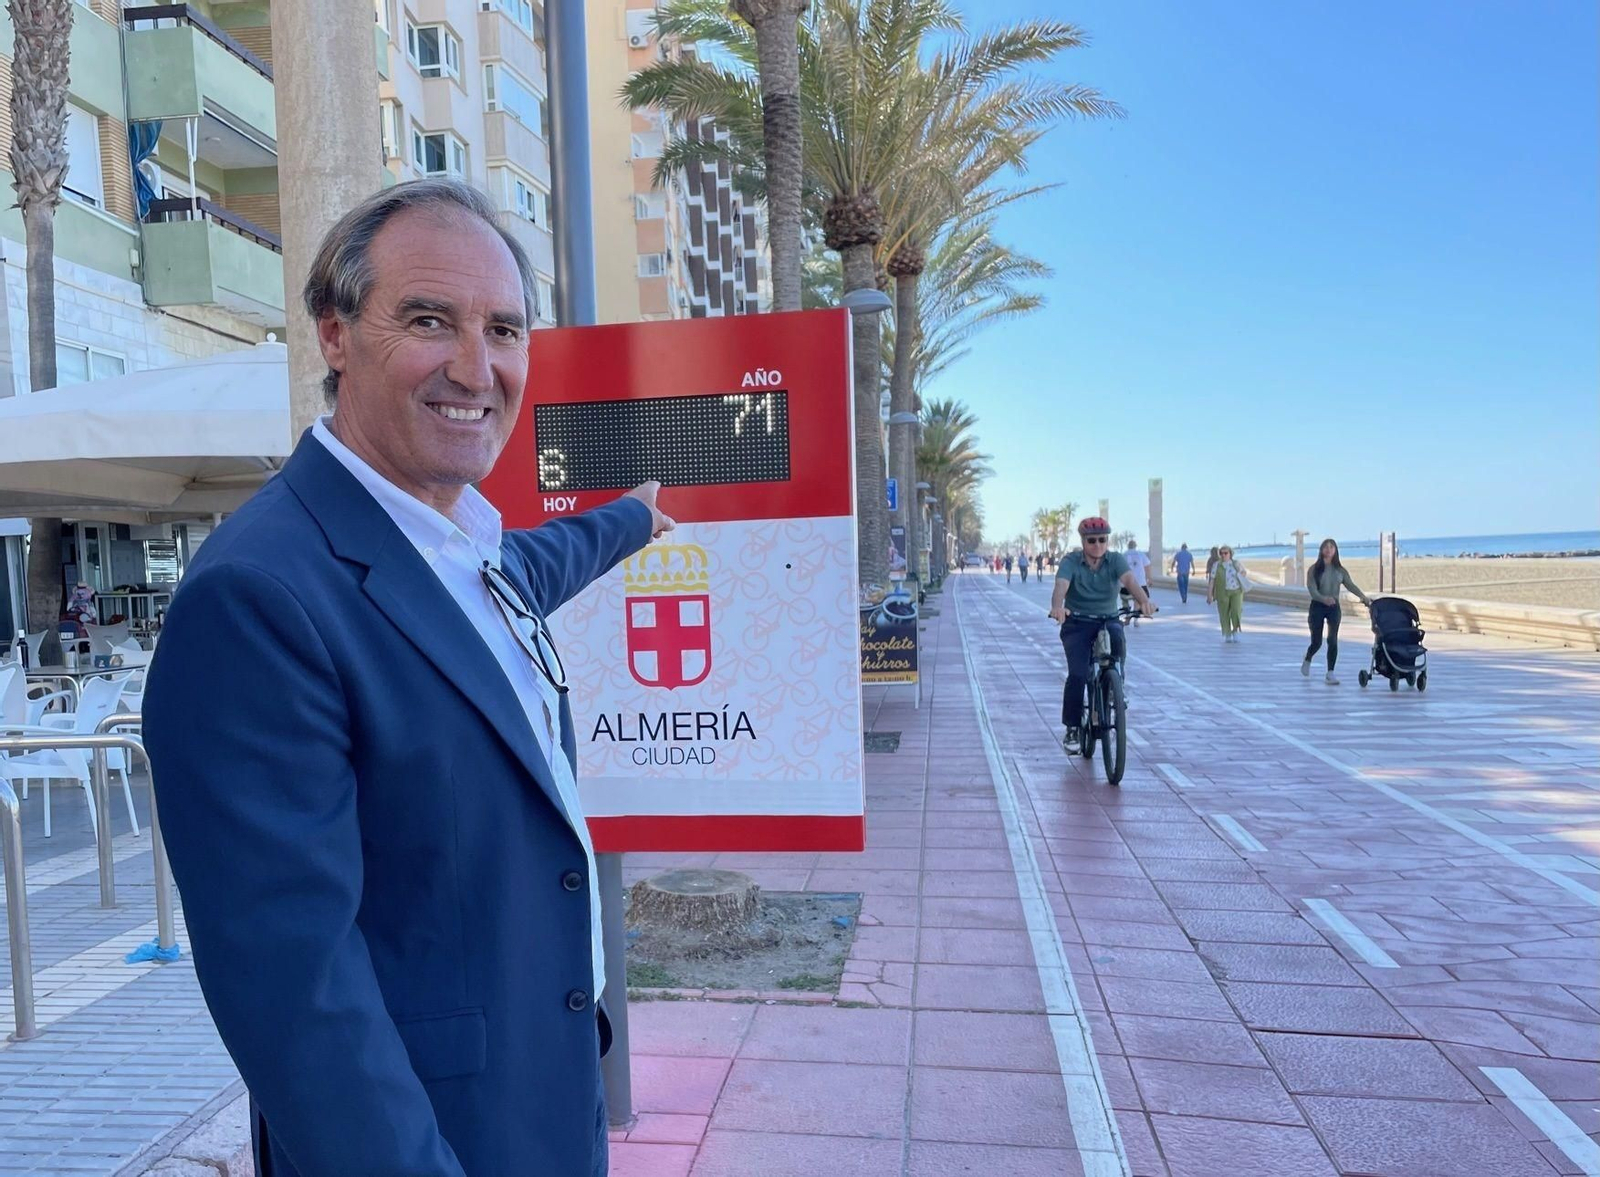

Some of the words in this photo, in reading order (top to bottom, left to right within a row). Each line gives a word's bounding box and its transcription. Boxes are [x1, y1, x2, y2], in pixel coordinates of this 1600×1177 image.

[741, 367, 782, 388] AÑO
[723, 393, 772, 435] 71
[543, 496, 577, 512] HOY
[860, 626, 876, 637] ay
[861, 656, 910, 669] hurros
[591, 704, 757, 742] ALMERÍA
[631, 746, 716, 766] CIUDAD
